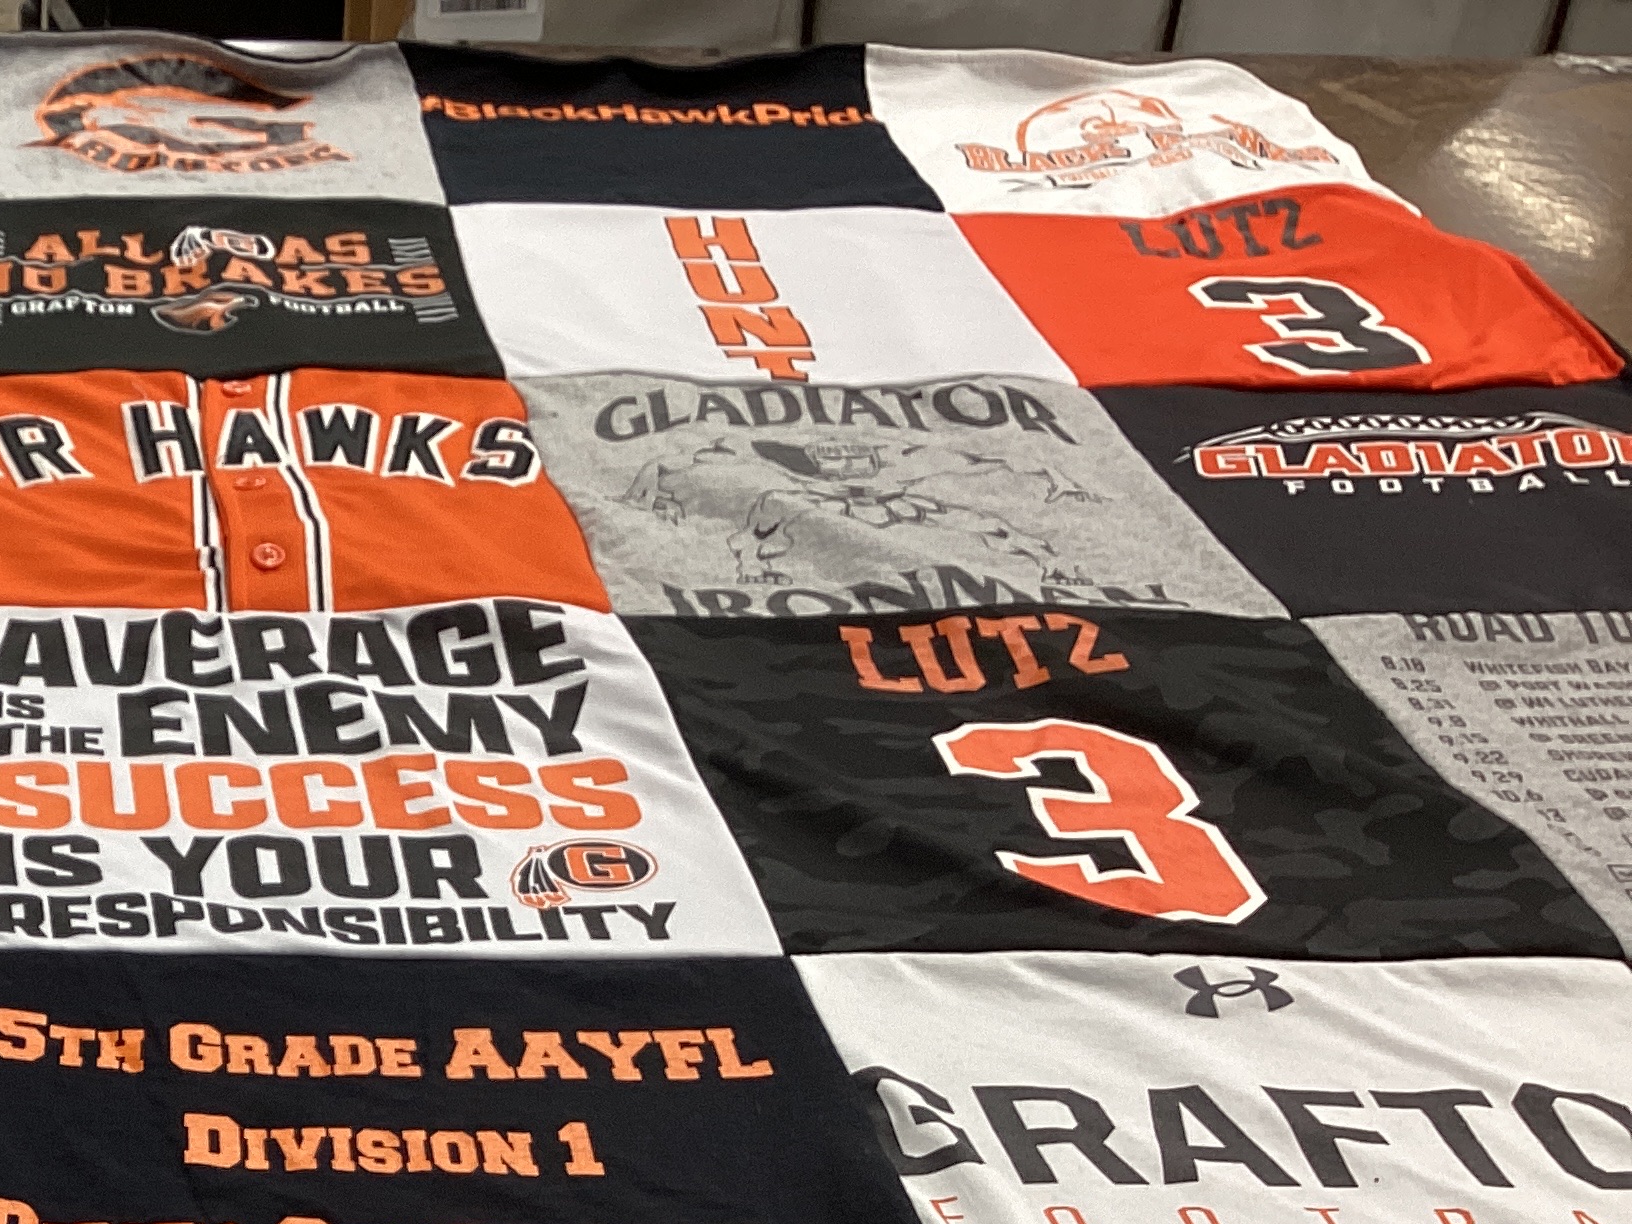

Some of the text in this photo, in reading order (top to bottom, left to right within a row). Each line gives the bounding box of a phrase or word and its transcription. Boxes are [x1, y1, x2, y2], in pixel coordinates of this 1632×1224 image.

[24, 229, 165, 263] ALL
[1119, 198, 1324, 260] LUTZ
[10, 297, 135, 316] GRAFTON
[104, 256, 447, 297] BRAKES
[269, 295, 407, 315] FOOTBALL
[665, 216, 816, 382] HUNT
[1187, 276, 1432, 376] 3
[122, 400, 541, 486] HAWKS
[594, 384, 1080, 446] GLADIATOR
[1283, 470, 1632, 496] FOOTBALL
[838, 612, 1131, 694] LUTZ
[1402, 612, 1555, 643] ROAD
[118, 680, 590, 757] ENEMY
[930, 718, 1268, 925] 3
[140, 834, 489, 901] YOUR
[169, 1021, 422, 1077] GRADE
[445, 1027, 774, 1081] AAYFL
[183, 1112, 605, 1177] DIVISION 1
